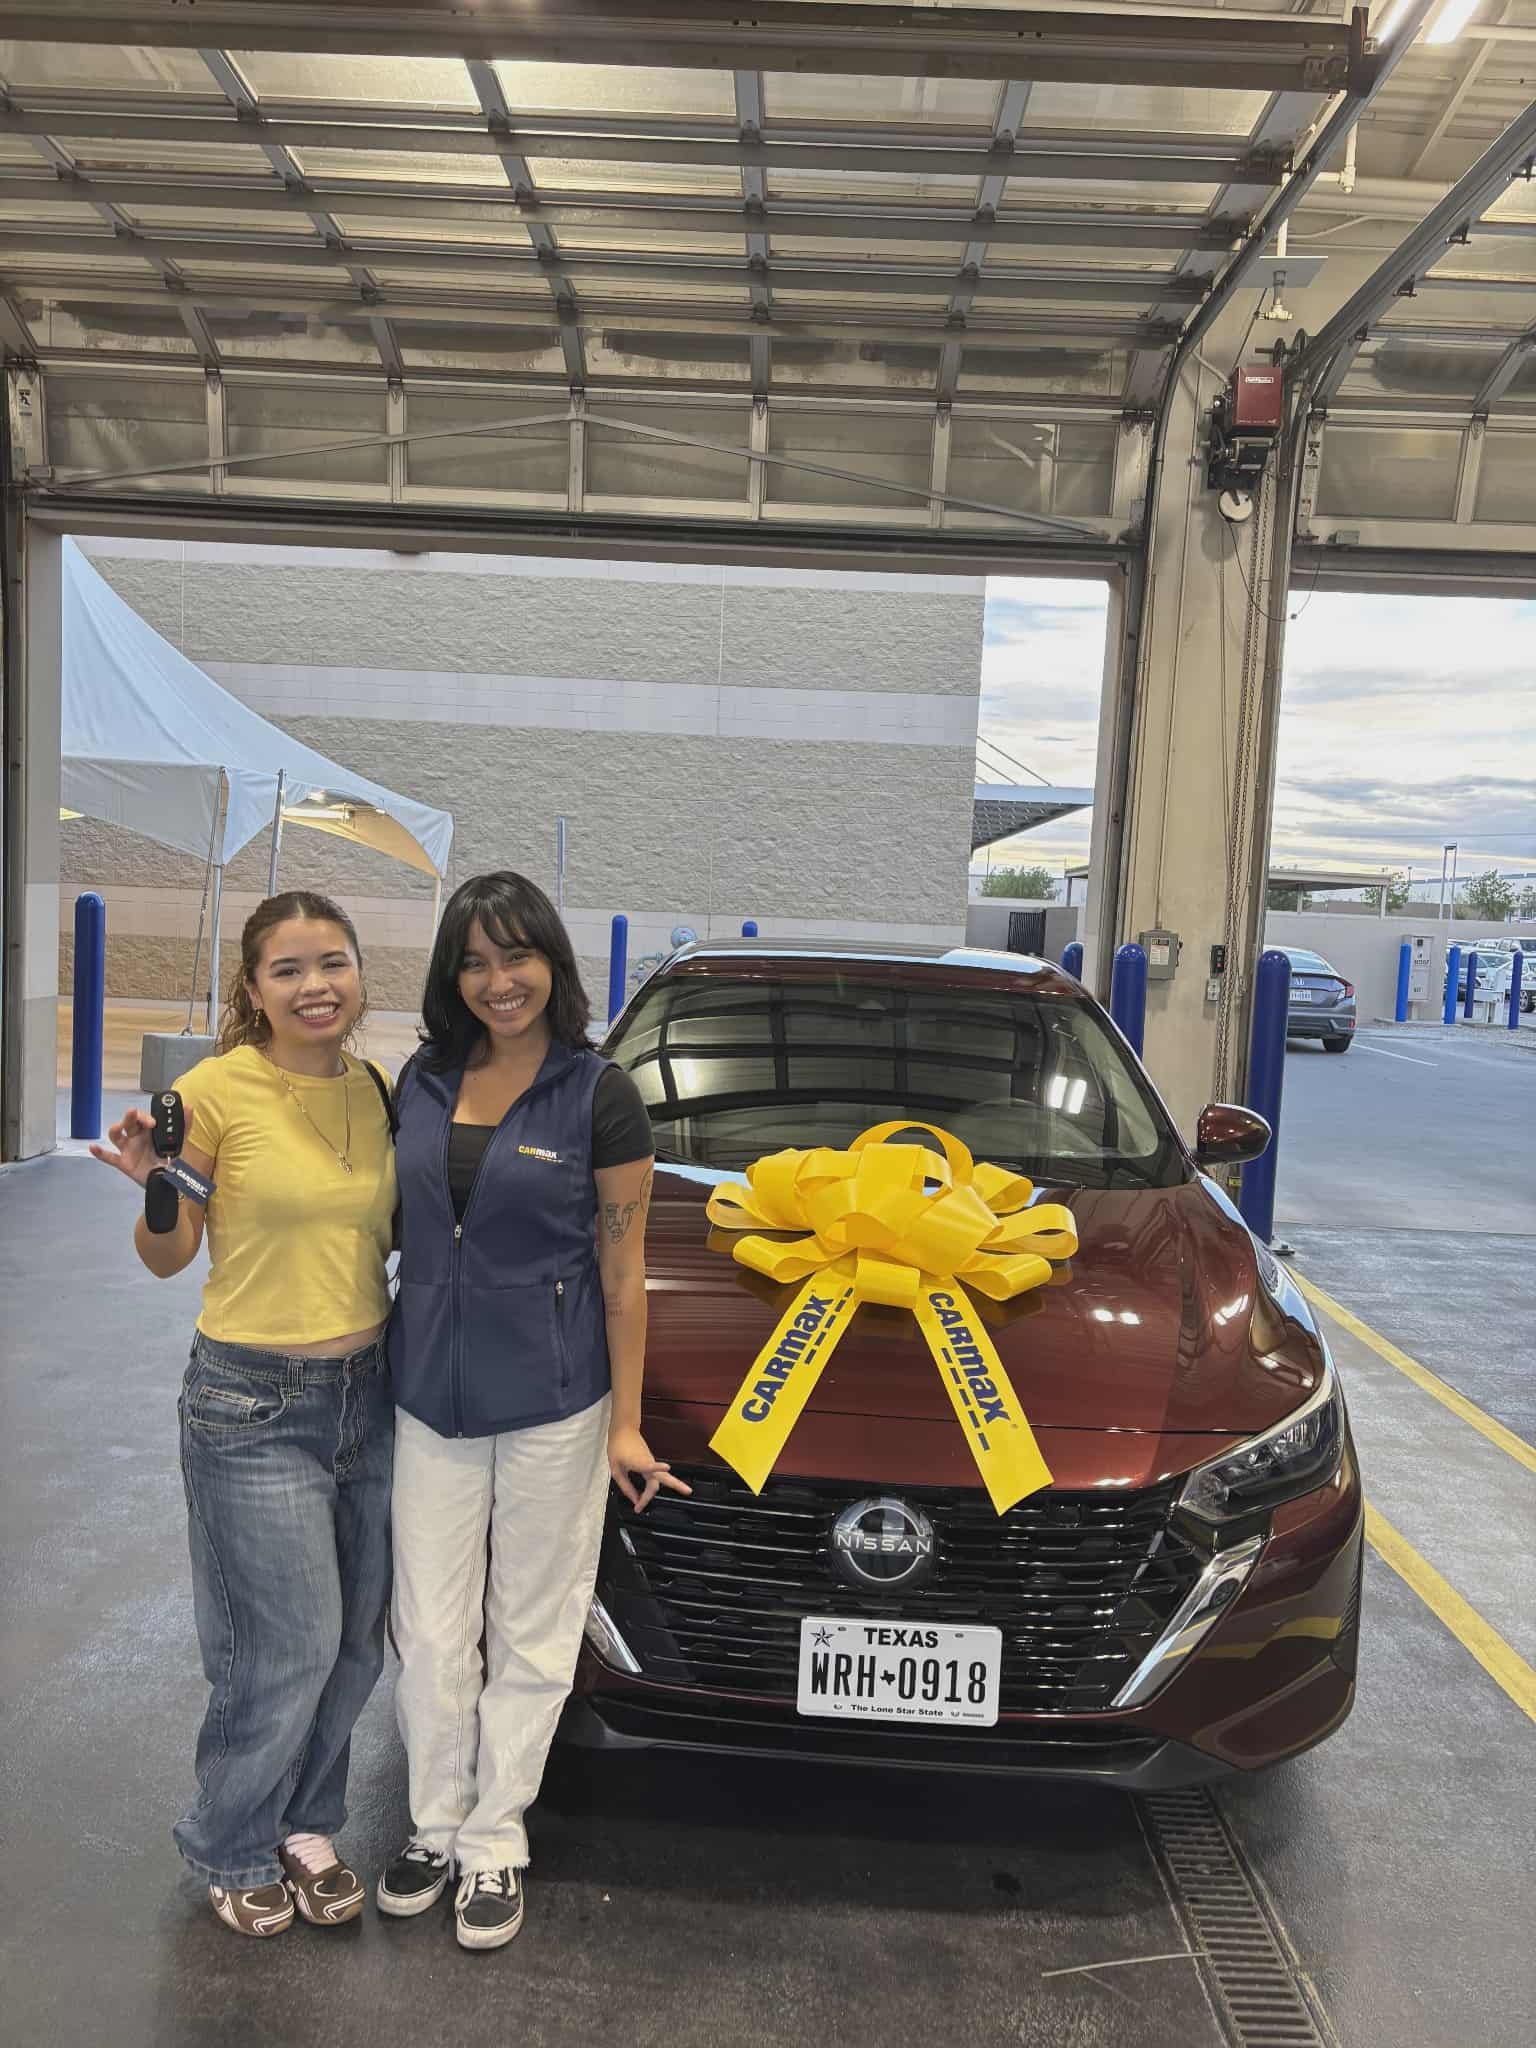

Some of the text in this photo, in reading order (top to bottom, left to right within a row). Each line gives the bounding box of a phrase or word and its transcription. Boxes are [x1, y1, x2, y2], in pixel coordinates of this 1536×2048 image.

[741, 1295, 834, 1423] CARmax
[928, 1292, 1010, 1425] CARmax
[837, 1534, 930, 1552] NISSAN
[863, 1627, 938, 1648] TEXAS
[851, 1704, 943, 1717] The Lone Star State
